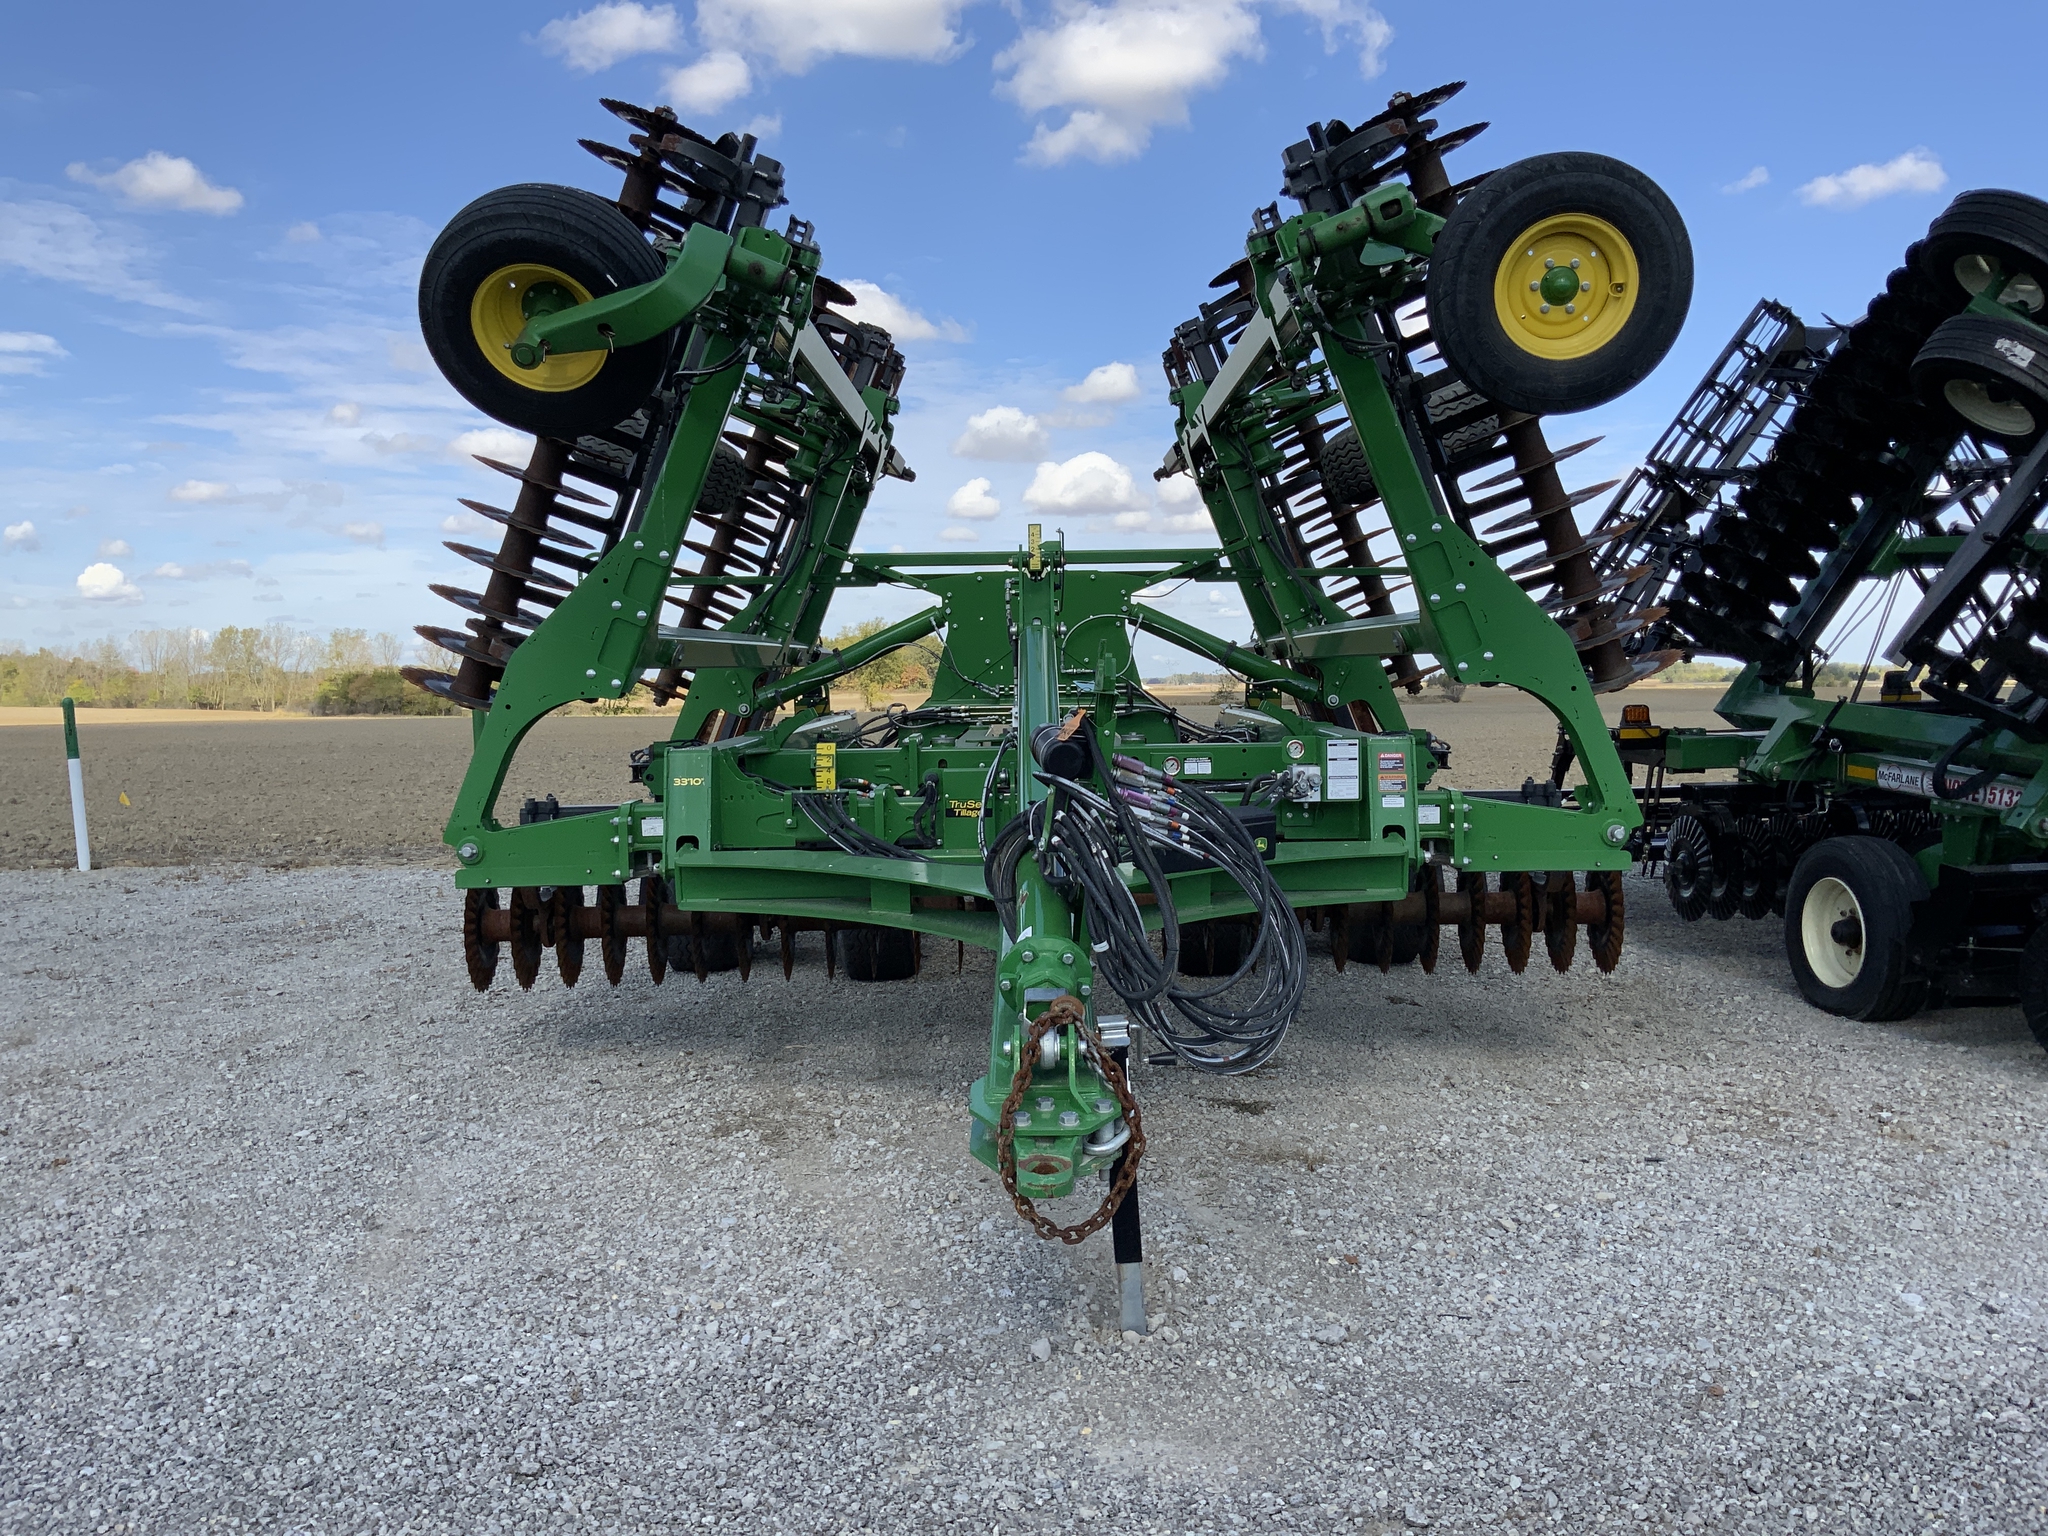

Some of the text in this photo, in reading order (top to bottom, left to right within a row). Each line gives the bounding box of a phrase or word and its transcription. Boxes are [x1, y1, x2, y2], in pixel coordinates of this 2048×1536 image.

[826, 755, 832, 763] 2
[826, 777, 832, 785] 6
[1878, 770, 1920, 787] McFARLANE
[949, 800, 983, 808] TruSe
